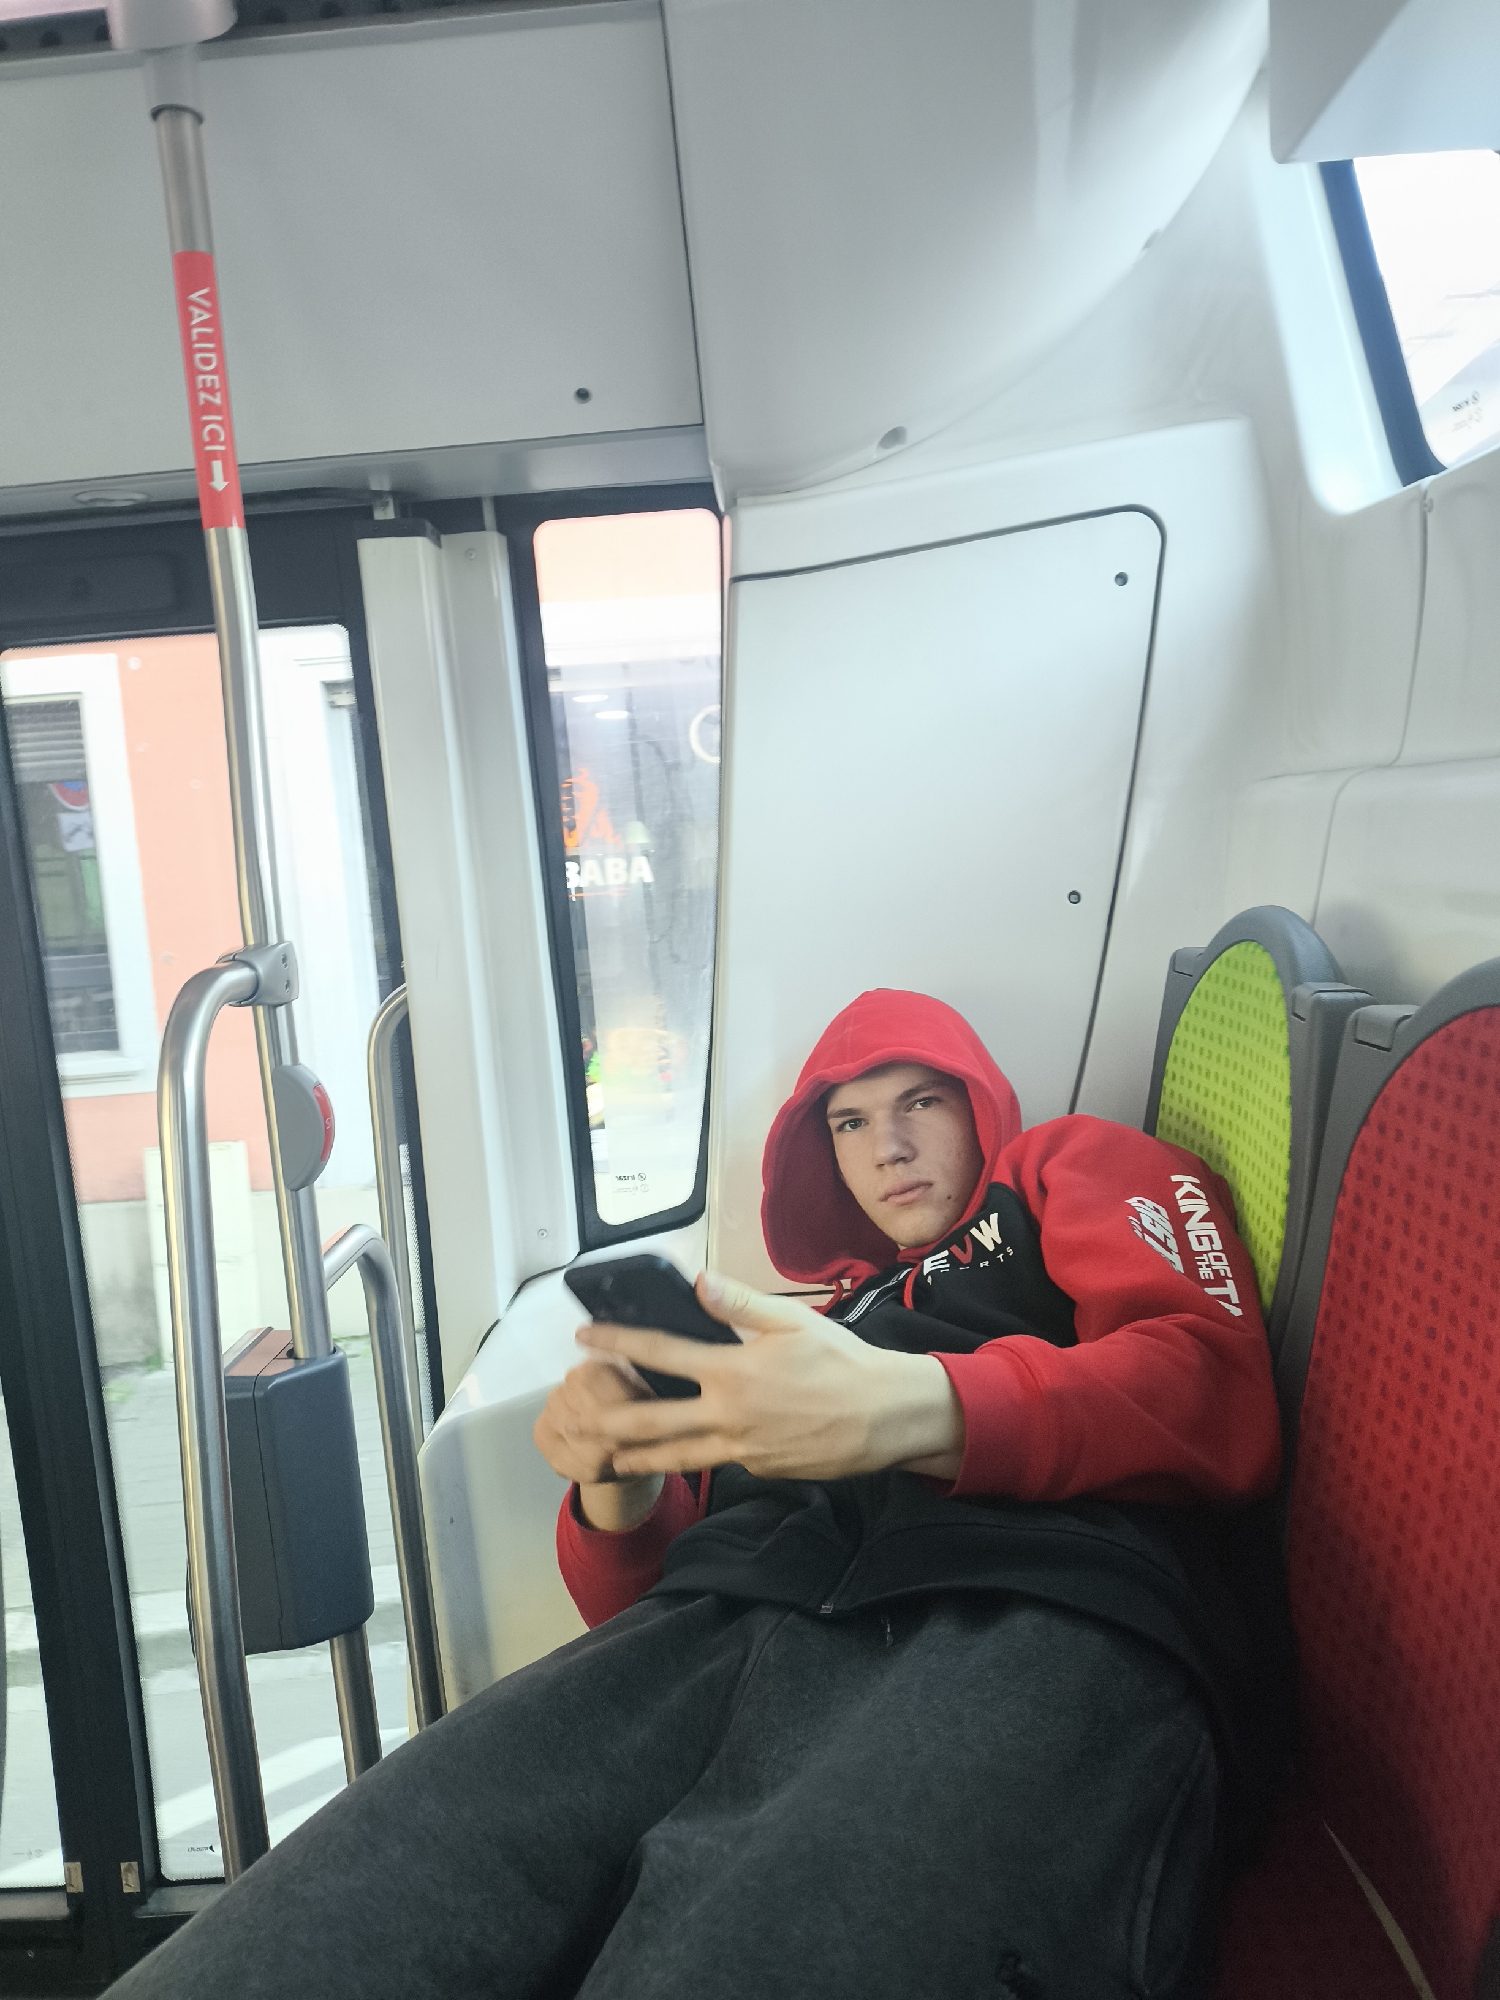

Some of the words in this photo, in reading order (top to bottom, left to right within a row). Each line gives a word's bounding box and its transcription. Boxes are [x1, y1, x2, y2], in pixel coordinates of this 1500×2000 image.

[187, 286, 222, 407] VALIDEZ
[200, 414, 227, 452] ICI
[1170, 1174, 1223, 1252] KING
[1194, 1253, 1215, 1280] THE
[1207, 1251, 1233, 1278] OF
